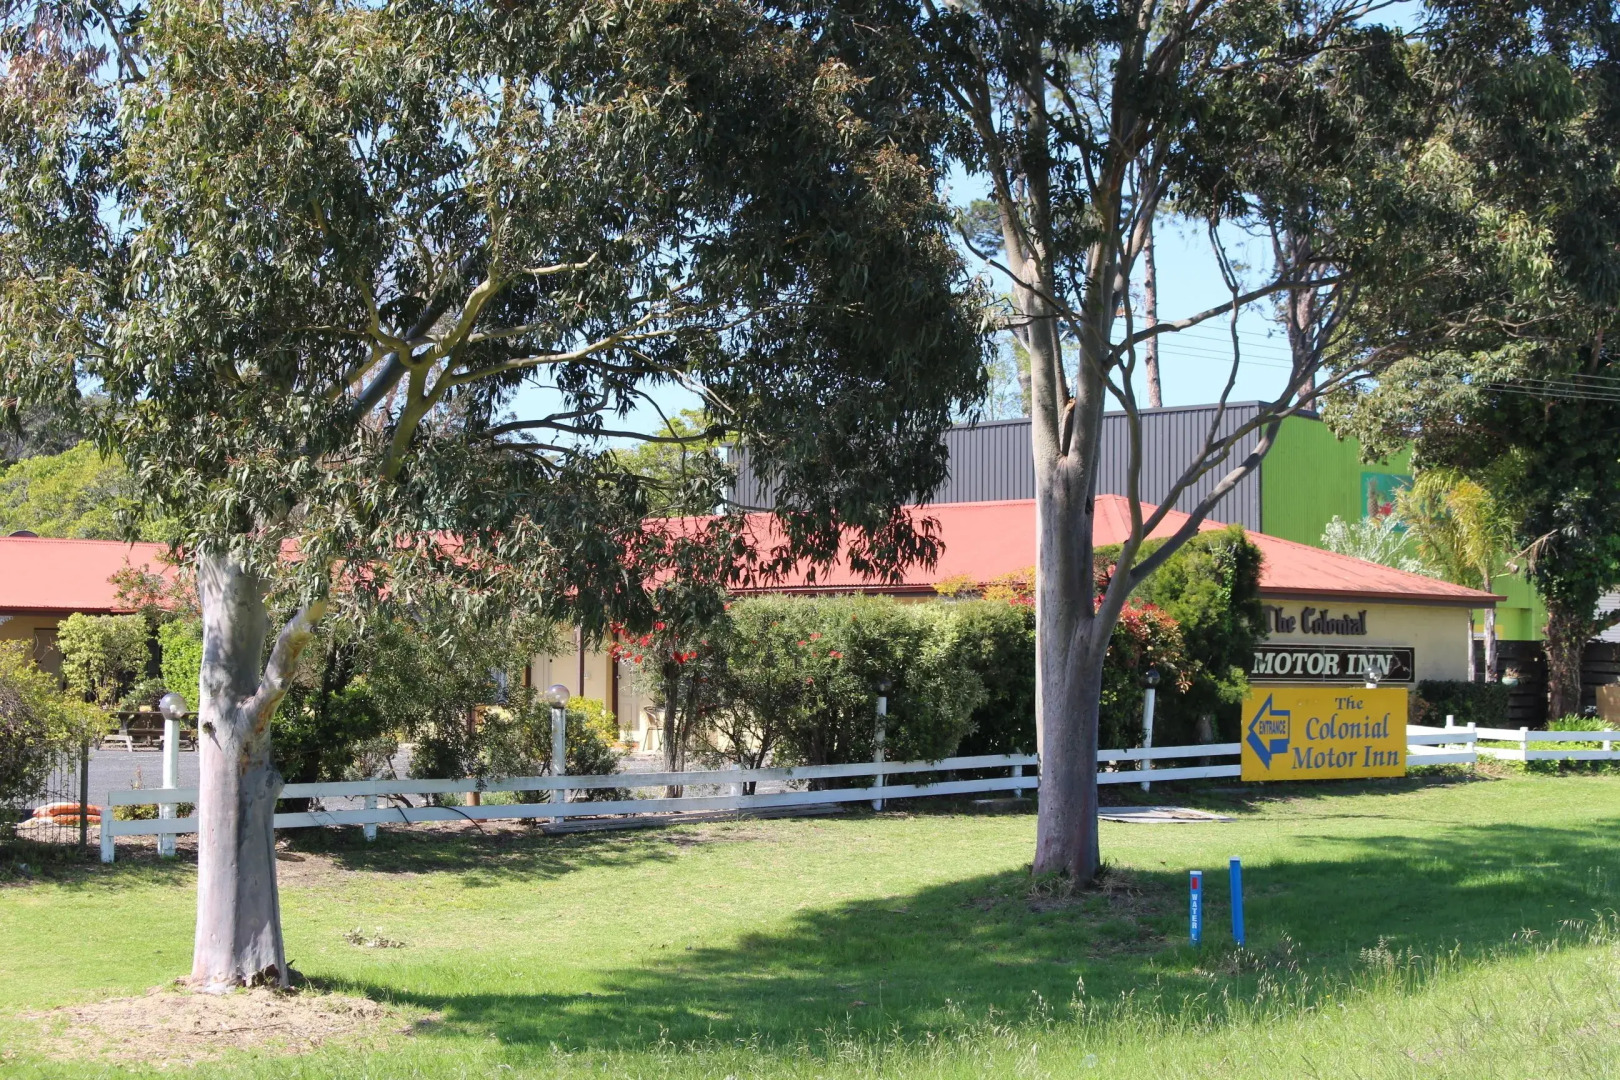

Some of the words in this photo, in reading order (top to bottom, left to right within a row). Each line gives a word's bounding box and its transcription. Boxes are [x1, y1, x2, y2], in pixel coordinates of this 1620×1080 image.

[1262, 604, 1297, 634] The
[1301, 606, 1368, 636] Colonial
[1251, 652, 1340, 675] MOTOR
[1345, 654, 1393, 676] INN
[1335, 695, 1364, 710] The
[1259, 720, 1286, 735] ENTRANCE
[1305, 713, 1390, 740] Colonial
[1291, 746, 1357, 770] Motor
[1362, 745, 1400, 768] Inn
